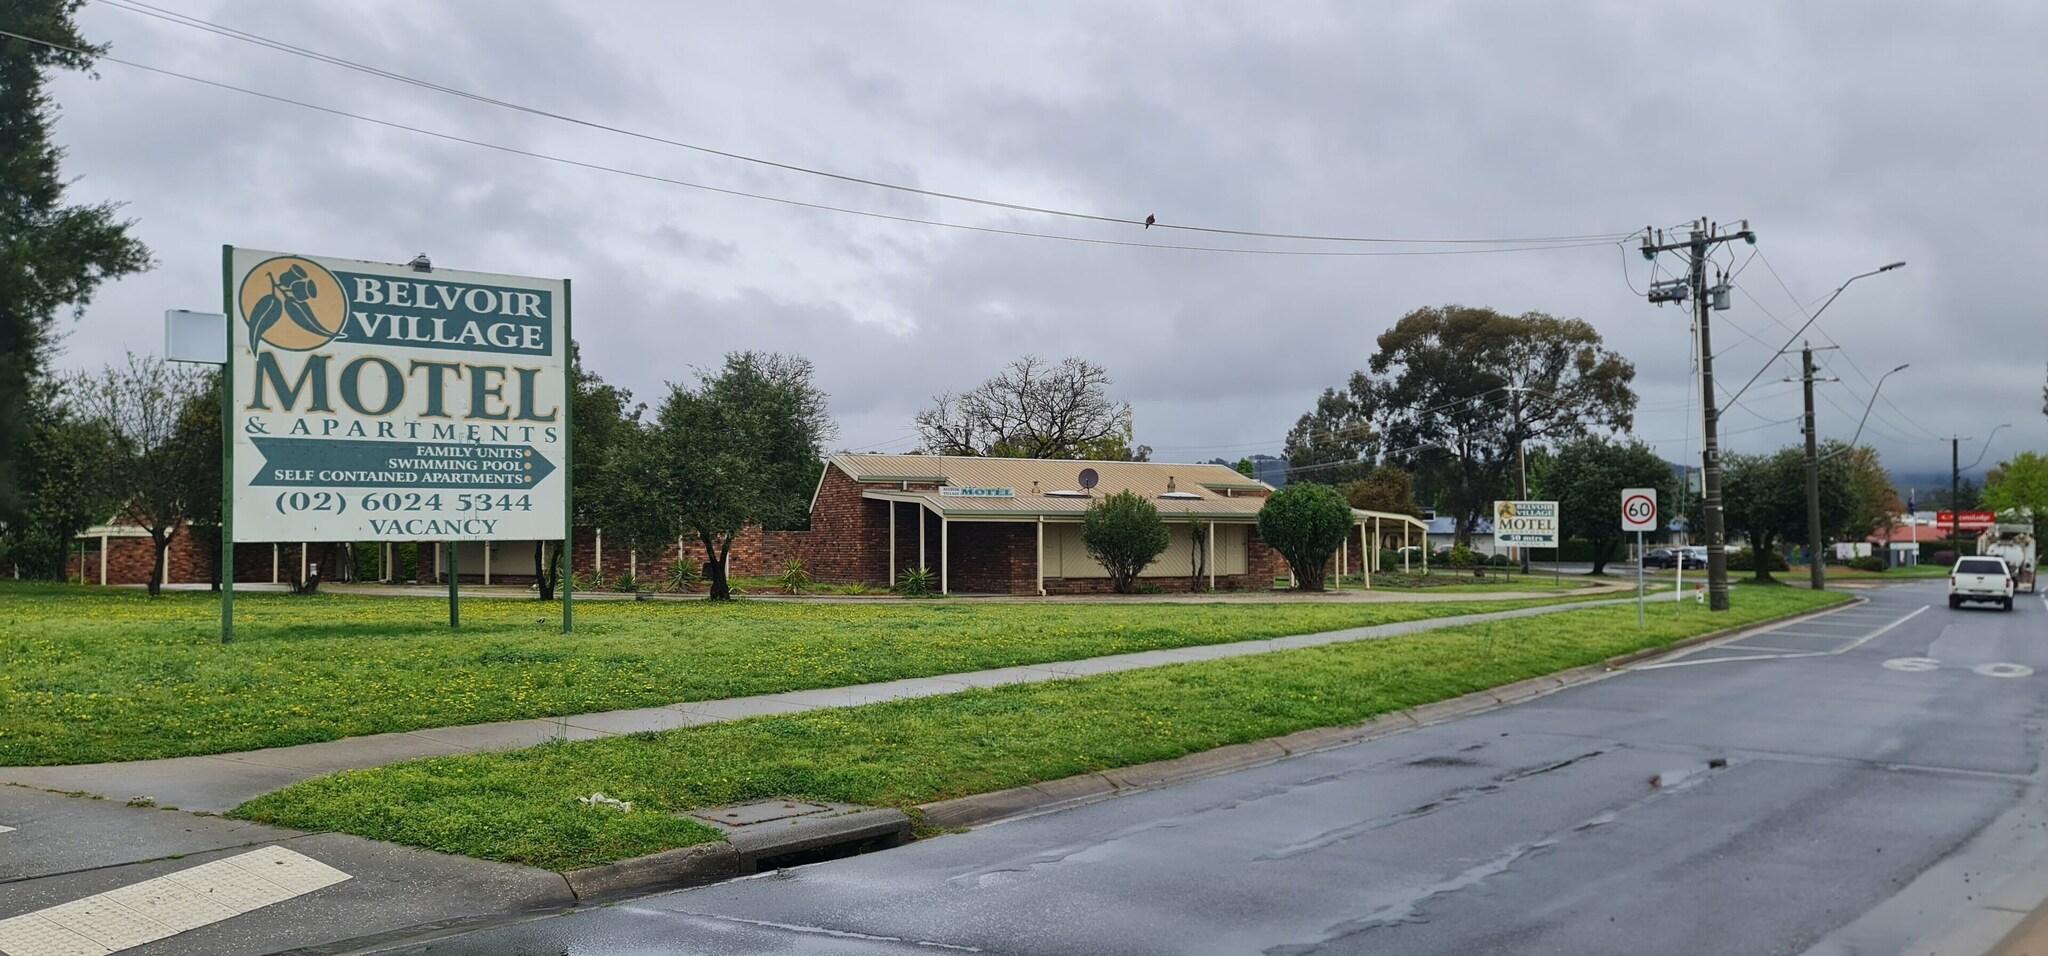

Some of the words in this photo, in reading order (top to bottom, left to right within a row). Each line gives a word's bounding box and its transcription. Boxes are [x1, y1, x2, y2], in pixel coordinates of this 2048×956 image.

[353, 277, 547, 319] BELVOIR
[352, 312, 544, 350] VILLAGE
[245, 350, 559, 422] MOTEL
[244, 415, 271, 435] &
[289, 418, 558, 443] APARTMENTS
[416, 446, 472, 458] FAMILY
[477, 448, 523, 459] UNITS
[388, 458, 478, 471] SWIMMING
[482, 459, 523, 471] POOL
[274, 468, 315, 481] SELF
[319, 469, 417, 483] CONTAINED
[421, 471, 523, 484] APARTMENTS
[961, 488, 1013, 496] MOTEL
[276, 491, 347, 515] (02)
[361, 492, 443, 512] 6024
[456, 493, 533, 512] 5344
[1629, 502, 1650, 517] 60
[368, 518, 499, 536] VACANCY
[1498, 519, 1556, 530] MOTEL
